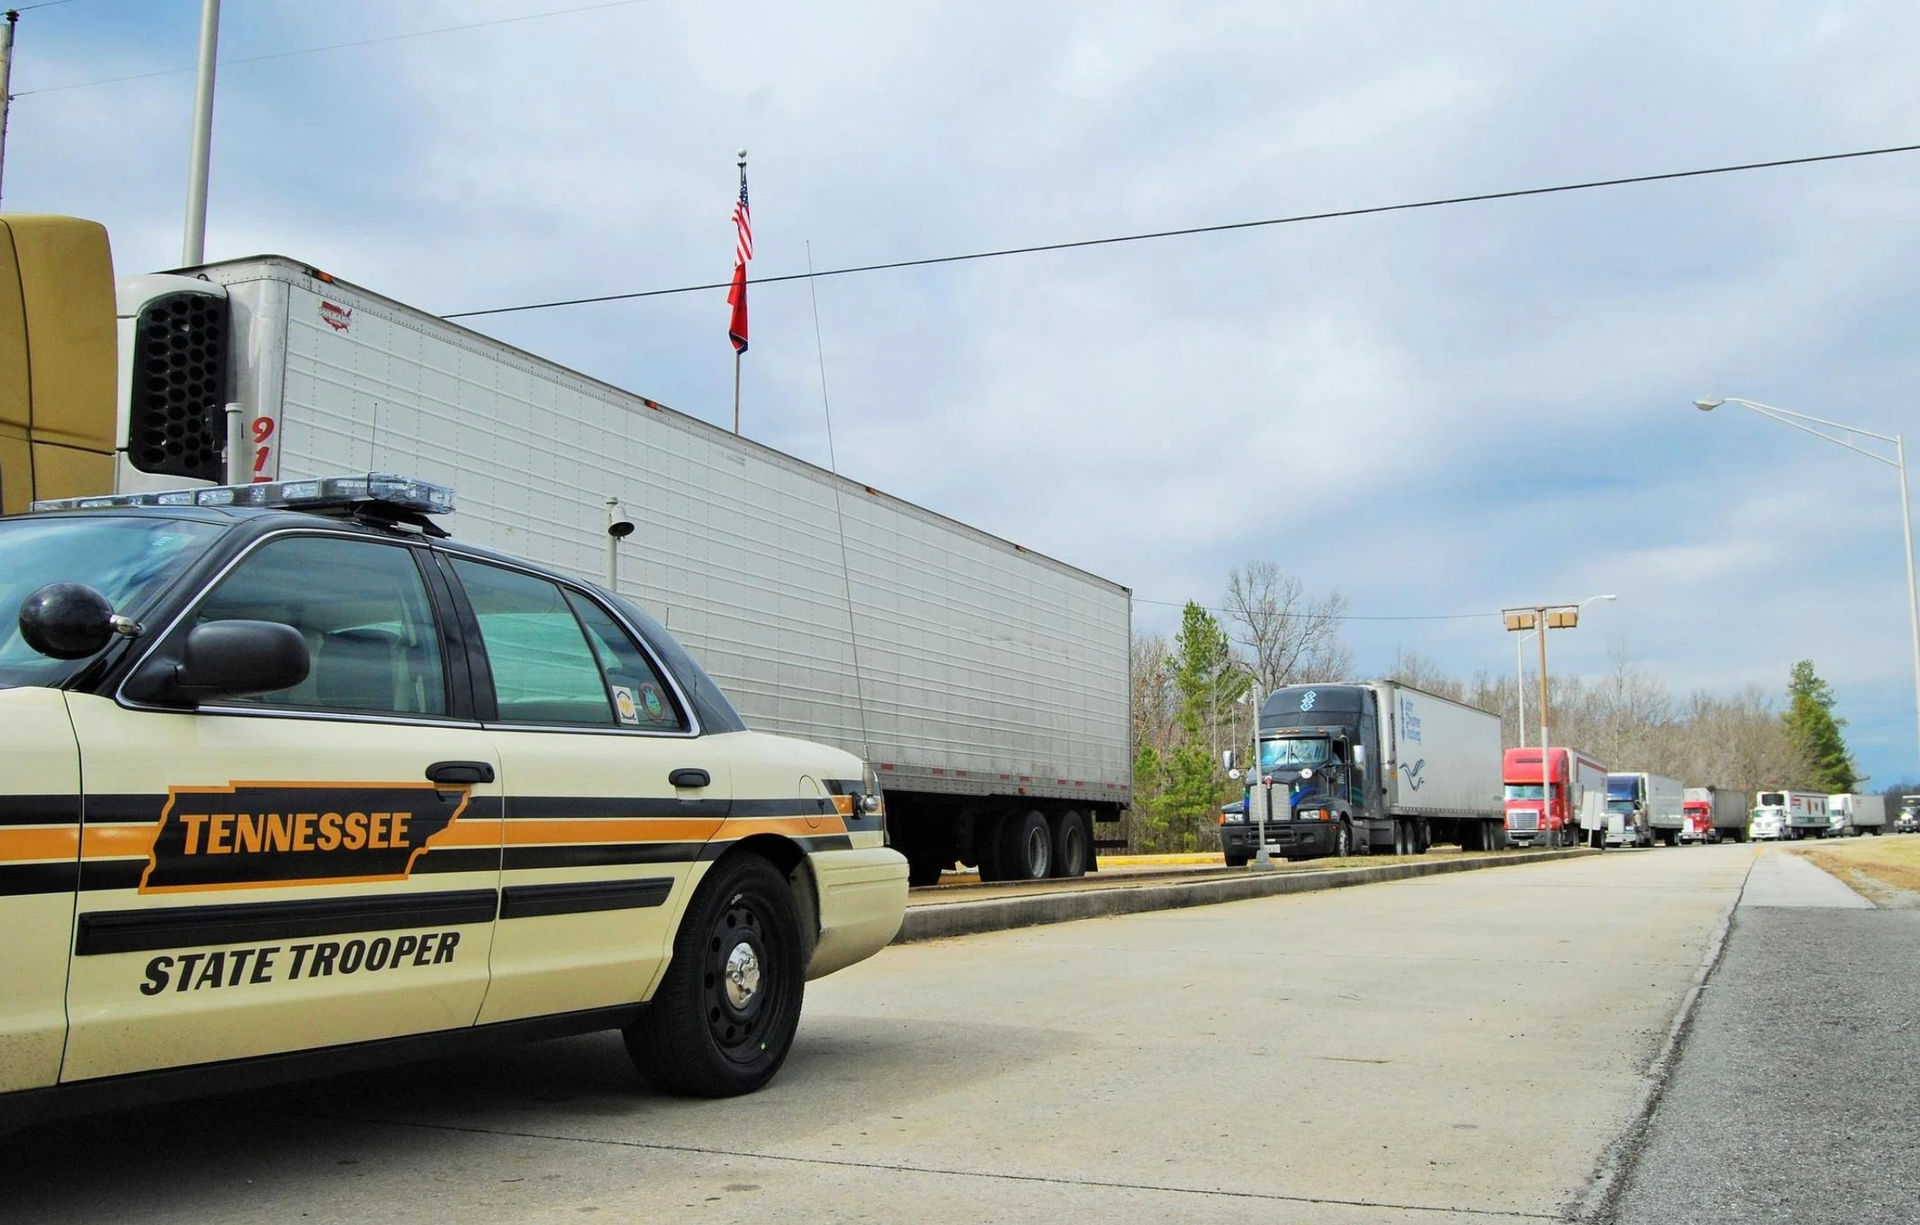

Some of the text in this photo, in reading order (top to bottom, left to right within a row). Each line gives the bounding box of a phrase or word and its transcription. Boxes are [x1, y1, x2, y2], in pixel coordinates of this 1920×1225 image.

[252, 416, 275, 483] 91
[179, 812, 412, 855] TENNESSEE
[139, 931, 461, 996] STATE TROOPER
